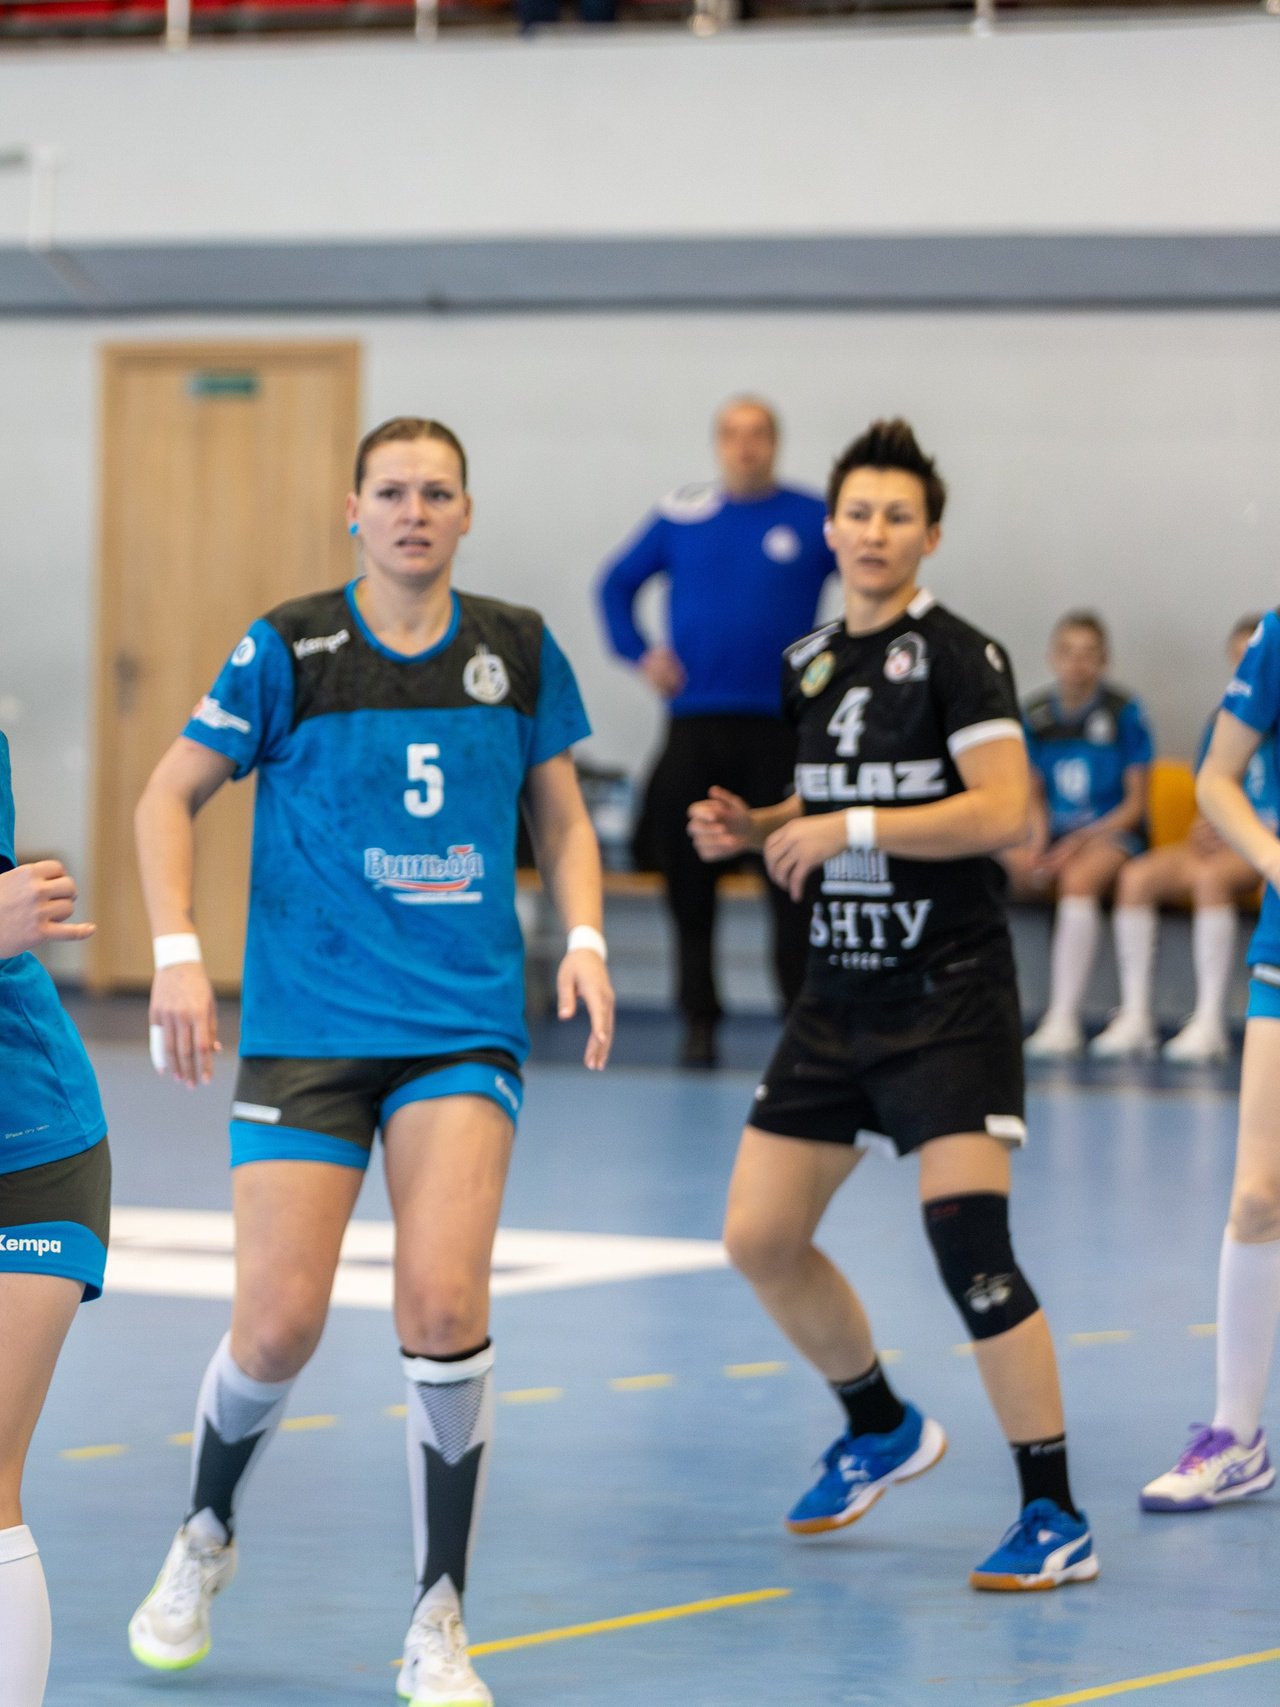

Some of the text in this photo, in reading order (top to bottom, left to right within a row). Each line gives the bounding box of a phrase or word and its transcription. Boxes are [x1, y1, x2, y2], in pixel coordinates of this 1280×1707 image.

[827, 686, 872, 758] 4
[404, 743, 444, 818] 5
[794, 758, 948, 802] ELAZ
